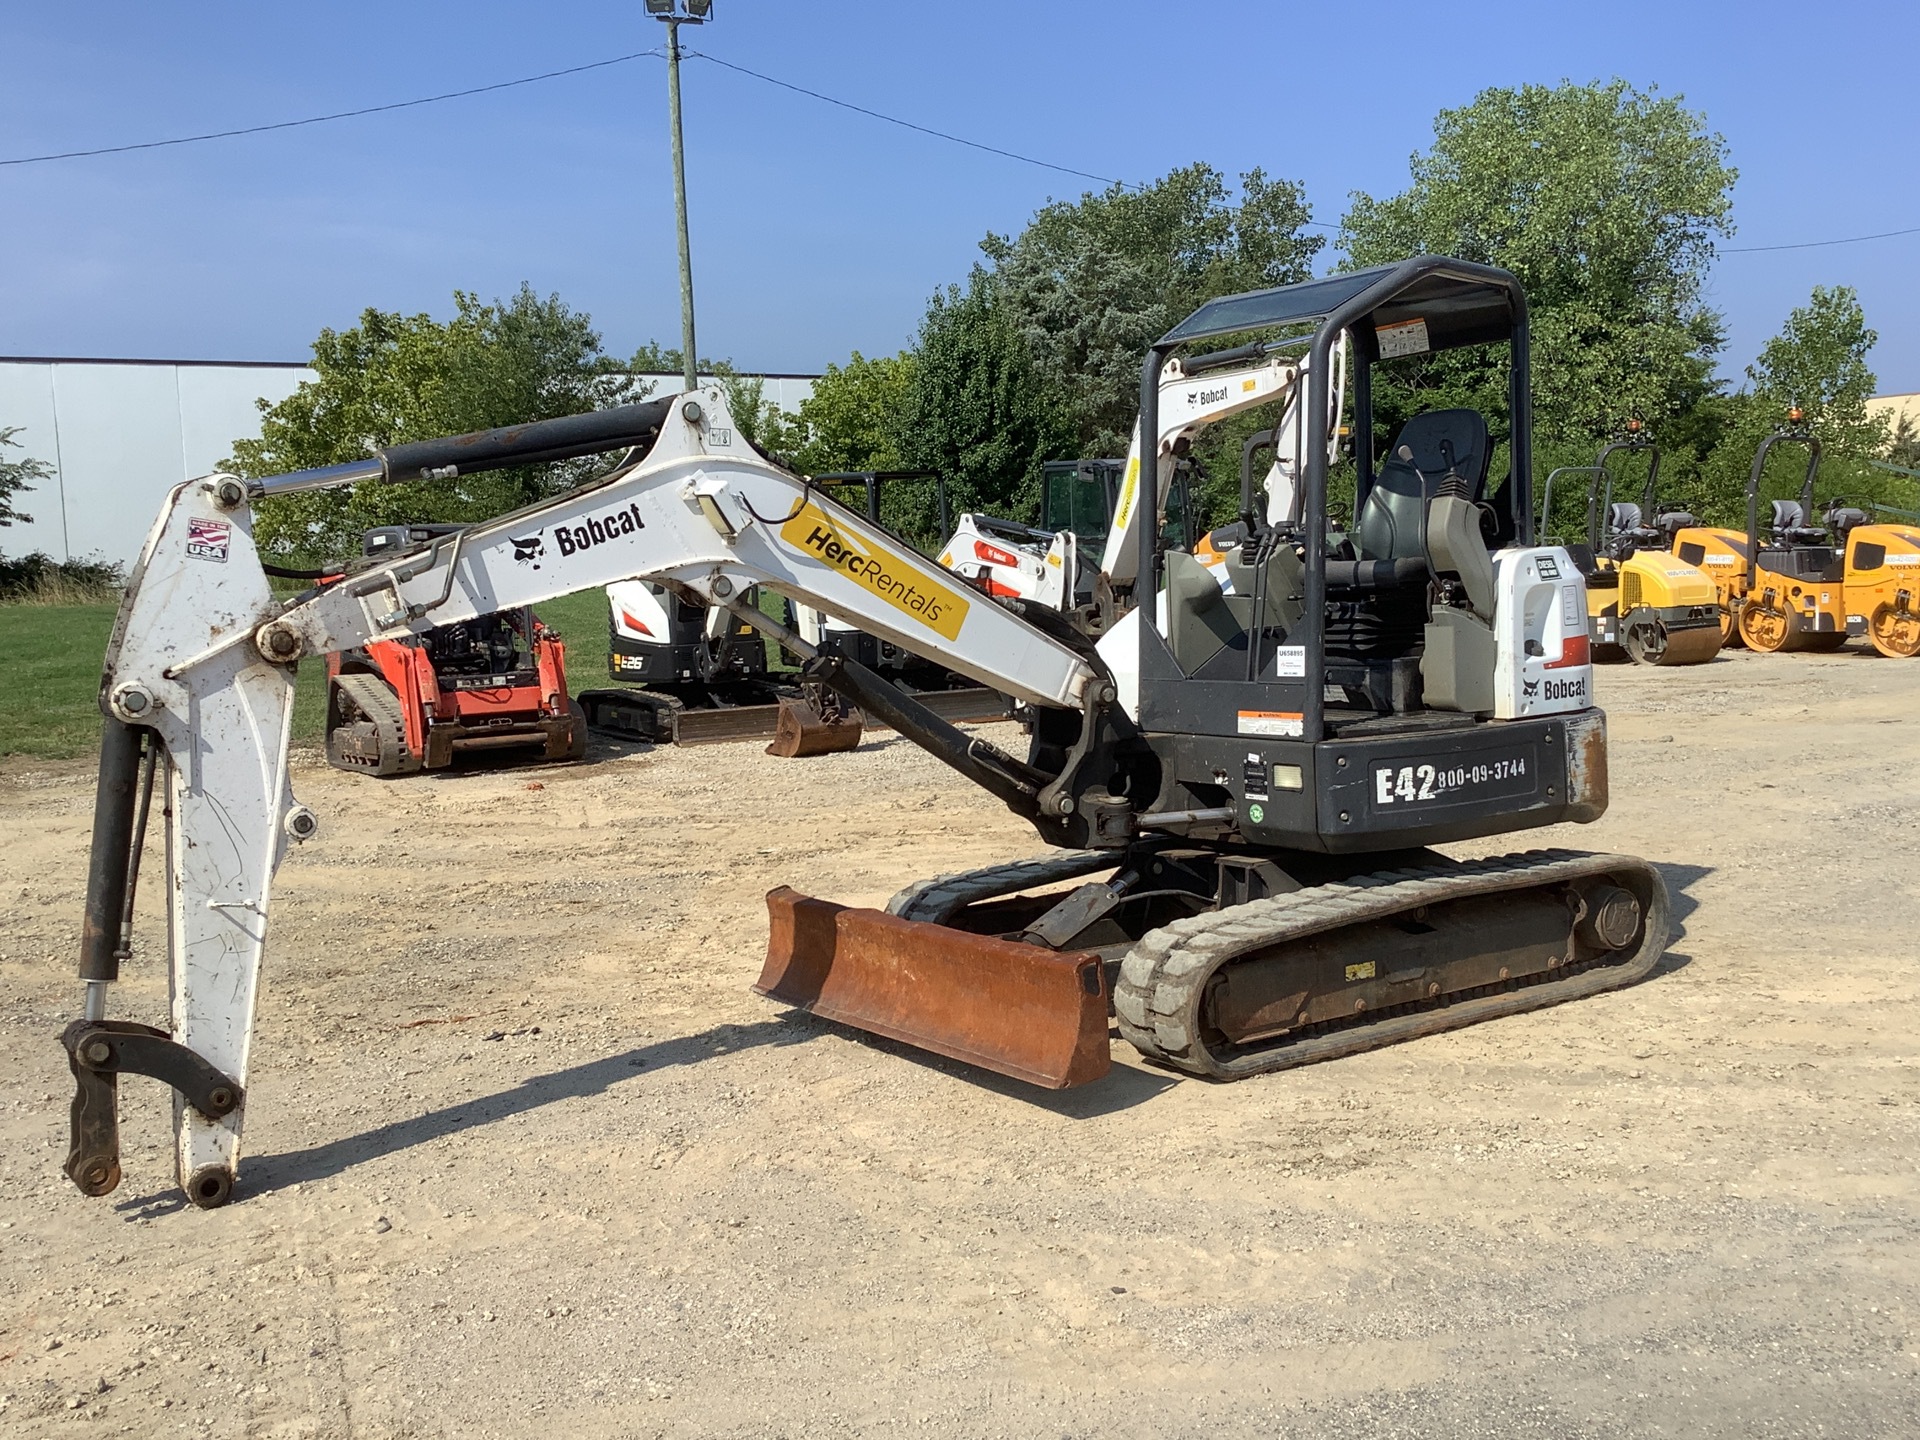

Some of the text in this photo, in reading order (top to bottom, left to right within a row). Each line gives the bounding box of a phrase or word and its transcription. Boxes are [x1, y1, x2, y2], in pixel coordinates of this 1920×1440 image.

[1200, 386, 1228, 405] Bobcat
[554, 503, 645, 557] Bobcat
[189, 545, 224, 558] USA
[805, 526, 942, 622] HercRentals
[1537, 560, 1556, 569] DIESEL
[621, 655, 643, 670] E26
[1544, 677, 1585, 701] Bobcat
[1375, 758, 1525, 804] E42 800-09-3744
